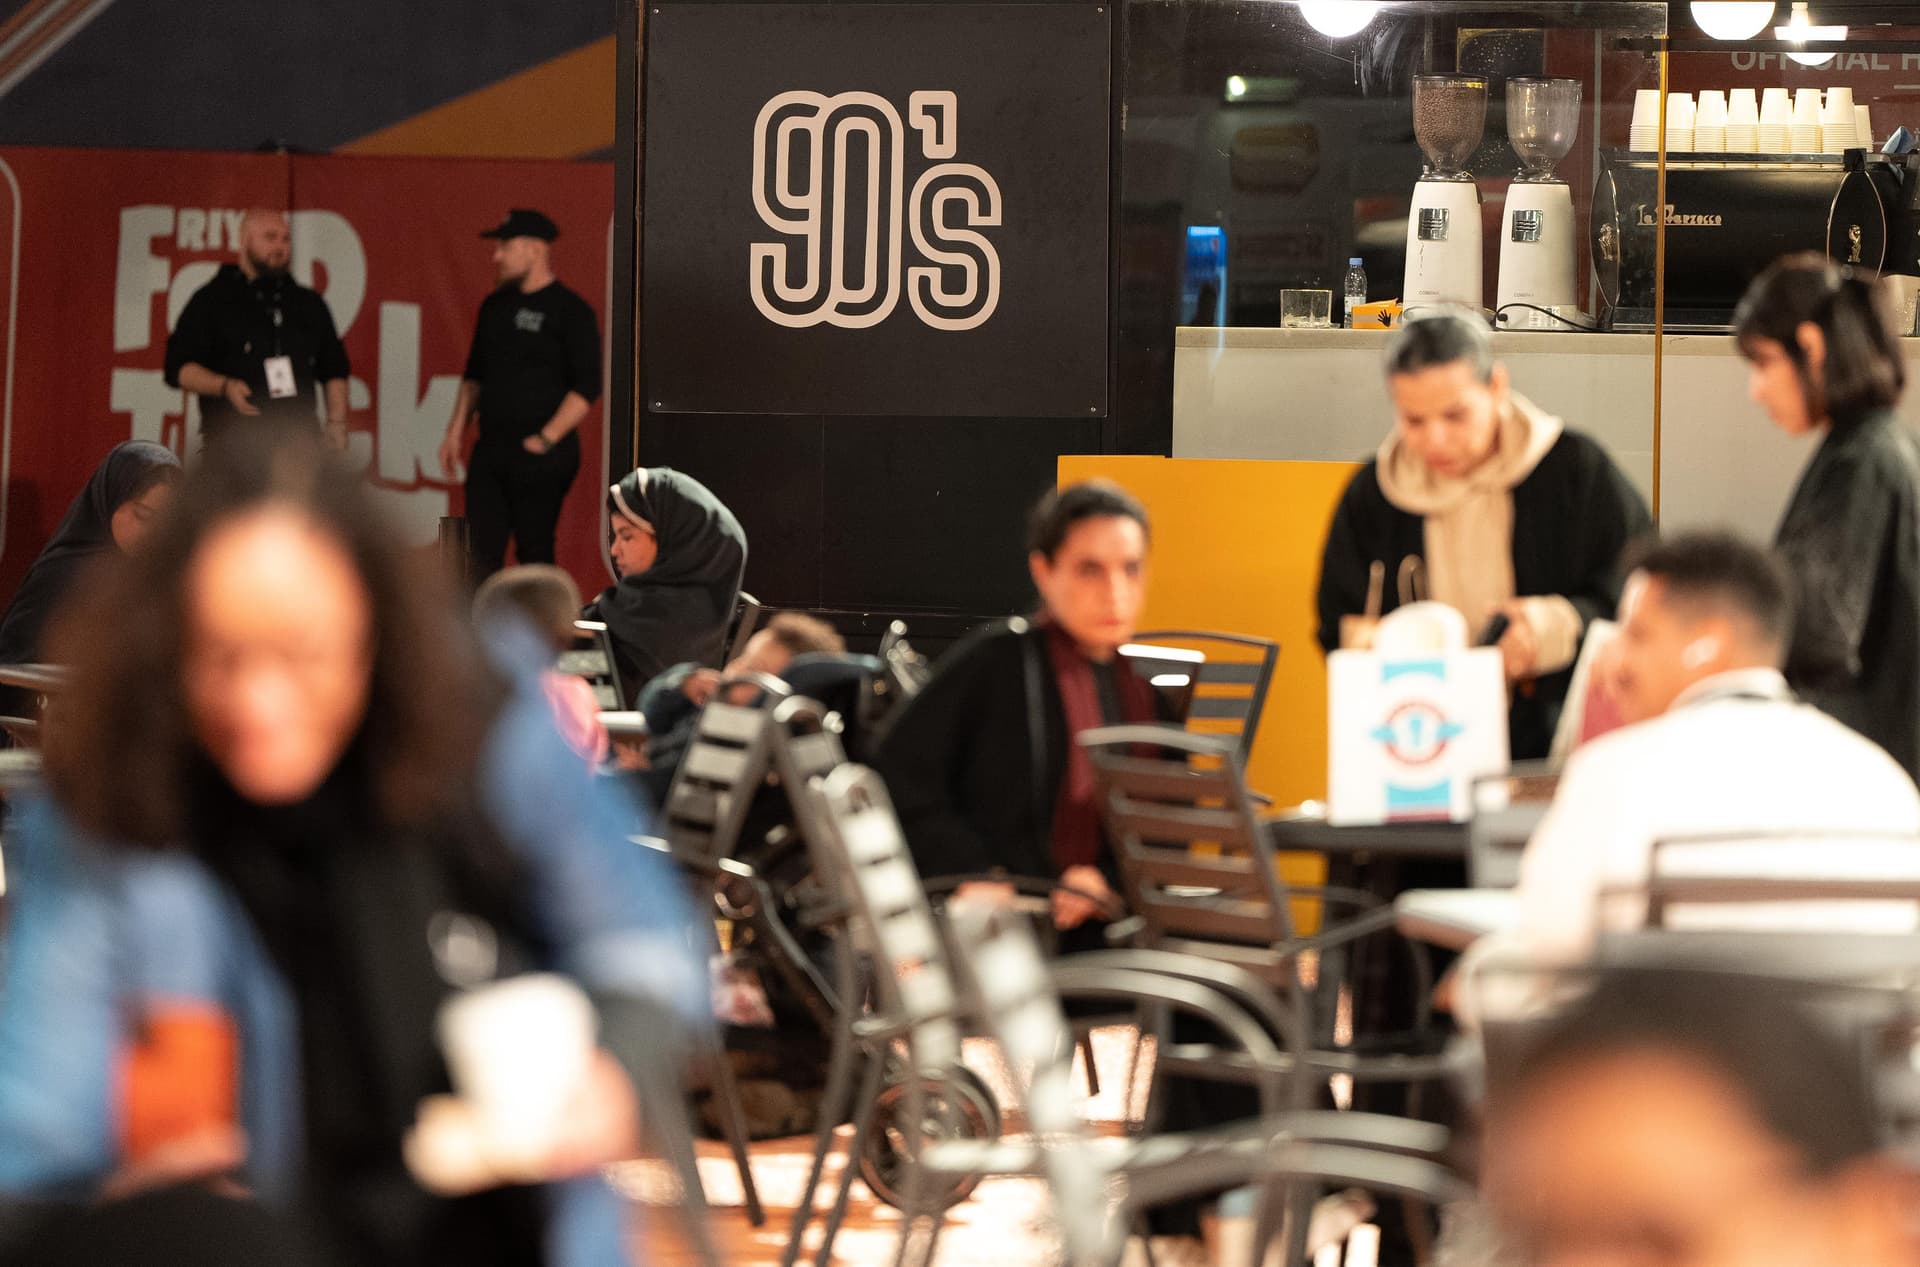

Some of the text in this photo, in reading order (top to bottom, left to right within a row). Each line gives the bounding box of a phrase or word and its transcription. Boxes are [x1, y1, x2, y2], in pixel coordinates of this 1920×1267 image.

[1731, 52, 1889, 71] OFFIAL
[176, 208, 250, 250] RIY
[750, 90, 1002, 331] 90's
